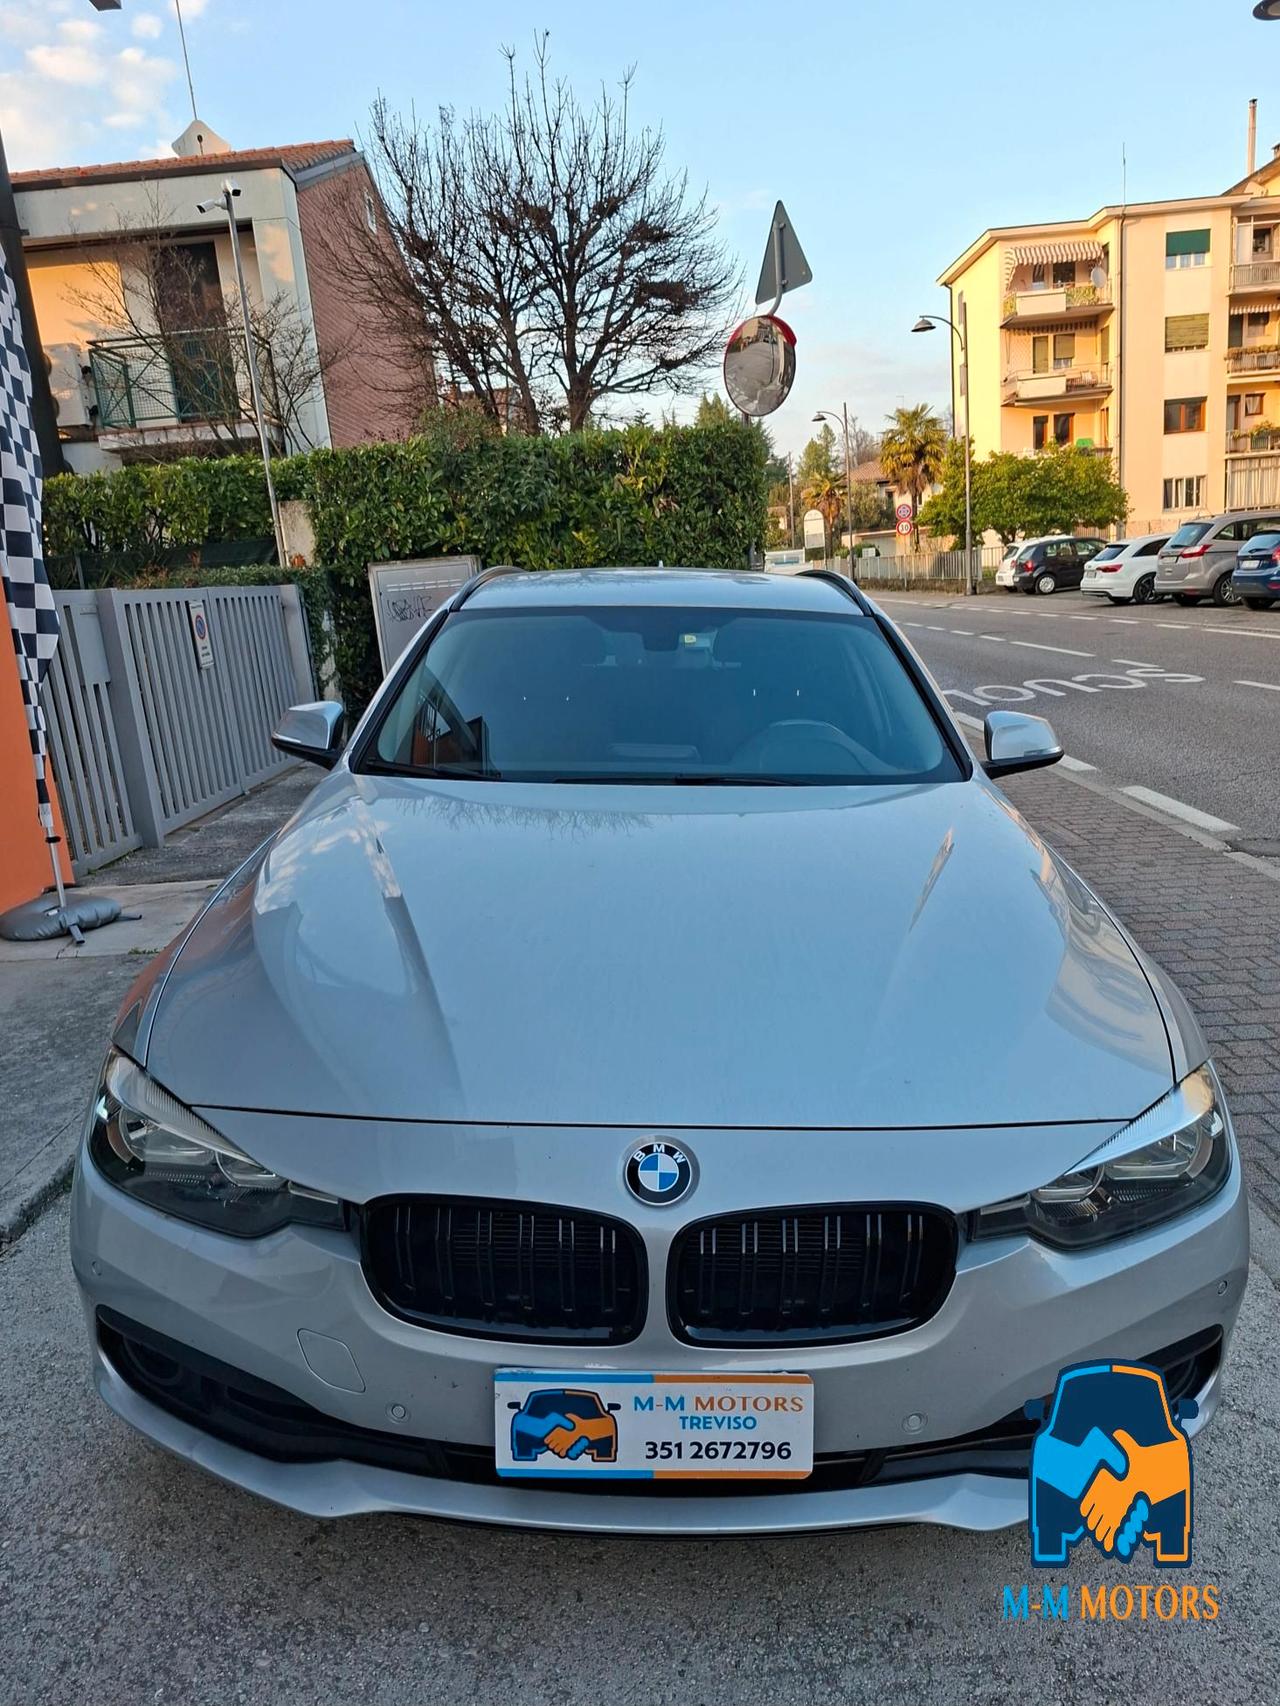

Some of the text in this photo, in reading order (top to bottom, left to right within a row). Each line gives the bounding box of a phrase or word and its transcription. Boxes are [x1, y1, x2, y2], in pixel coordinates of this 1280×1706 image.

[633, 1144, 686, 1163] BMW
[633, 1396, 803, 1412] M-M MOTORS
[679, 1415, 757, 1430] TREVISO
